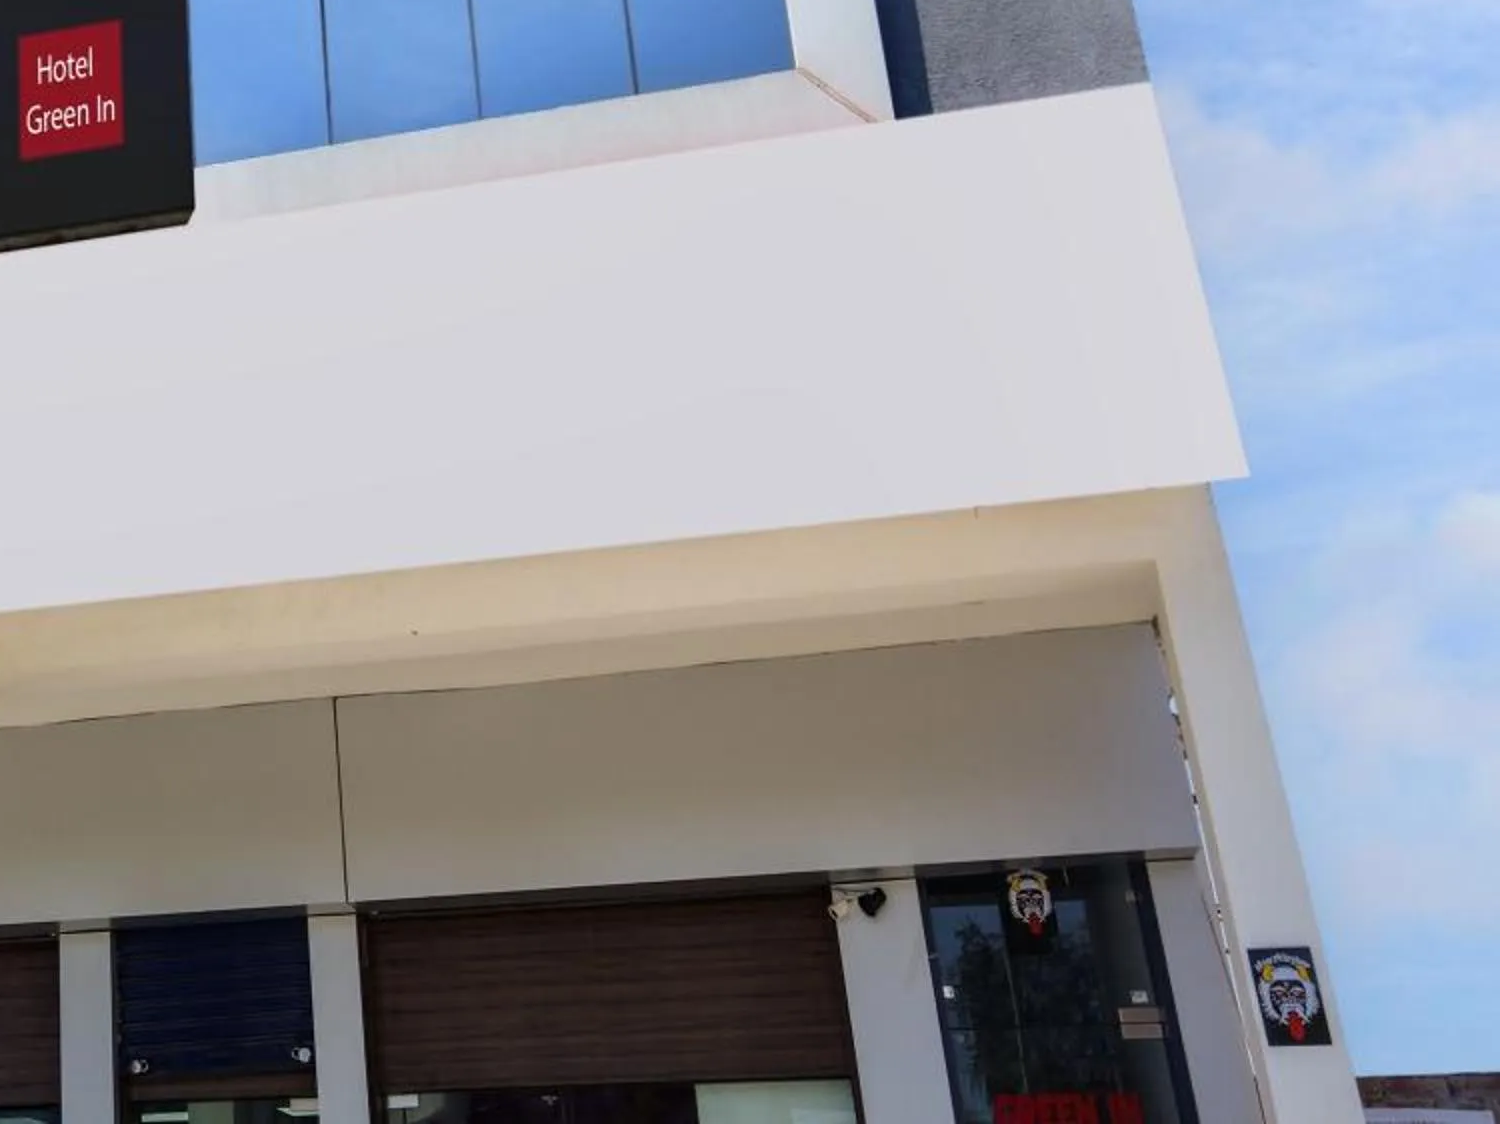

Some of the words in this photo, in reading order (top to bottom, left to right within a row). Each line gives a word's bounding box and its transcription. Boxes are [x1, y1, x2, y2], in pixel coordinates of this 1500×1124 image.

[37, 47, 94, 84] Hotel
[26, 103, 90, 136] Green
[96, 94, 116, 125] In
